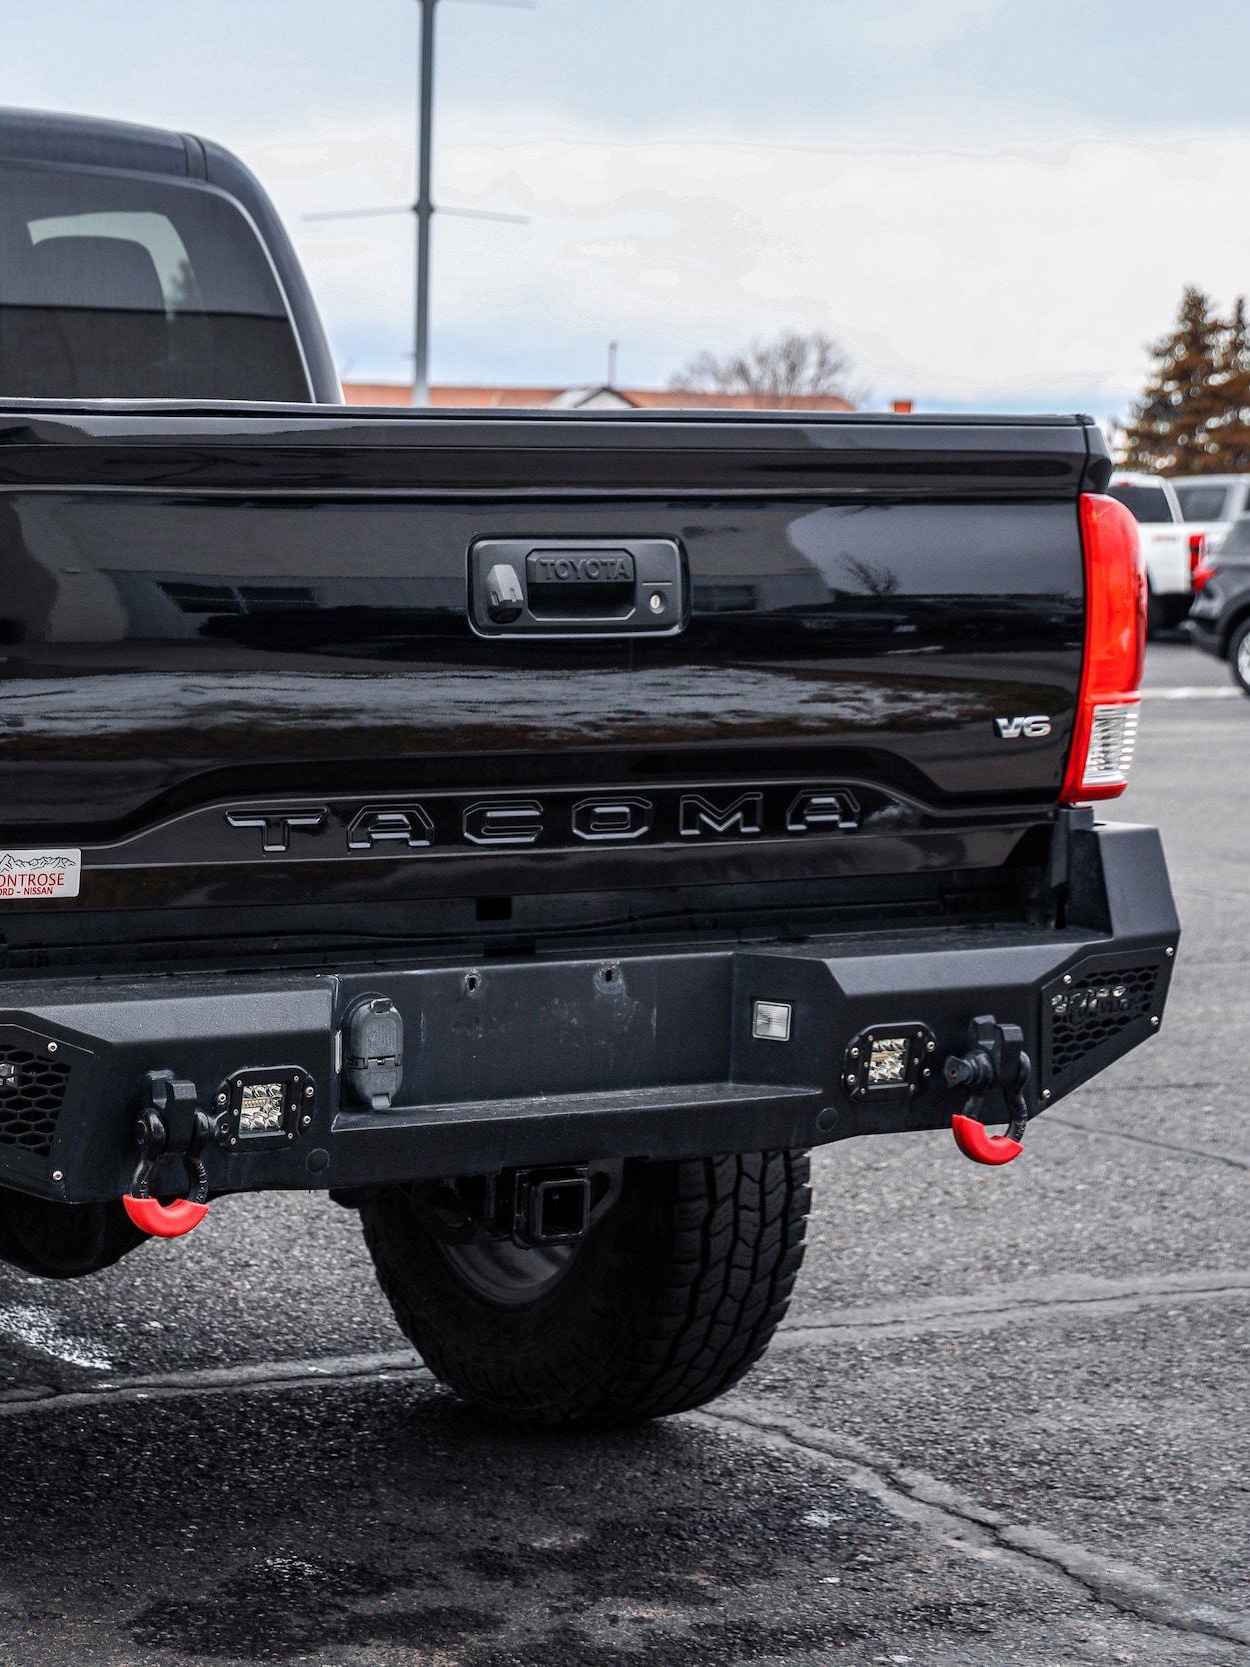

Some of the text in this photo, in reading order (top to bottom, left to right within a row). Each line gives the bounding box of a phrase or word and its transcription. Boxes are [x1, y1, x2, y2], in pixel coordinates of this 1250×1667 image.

[540, 558, 631, 581] TOYOTA
[993, 714, 1052, 739] V6
[224, 788, 861, 853] TACOMA
[23, 886, 54, 896] NISSAN
